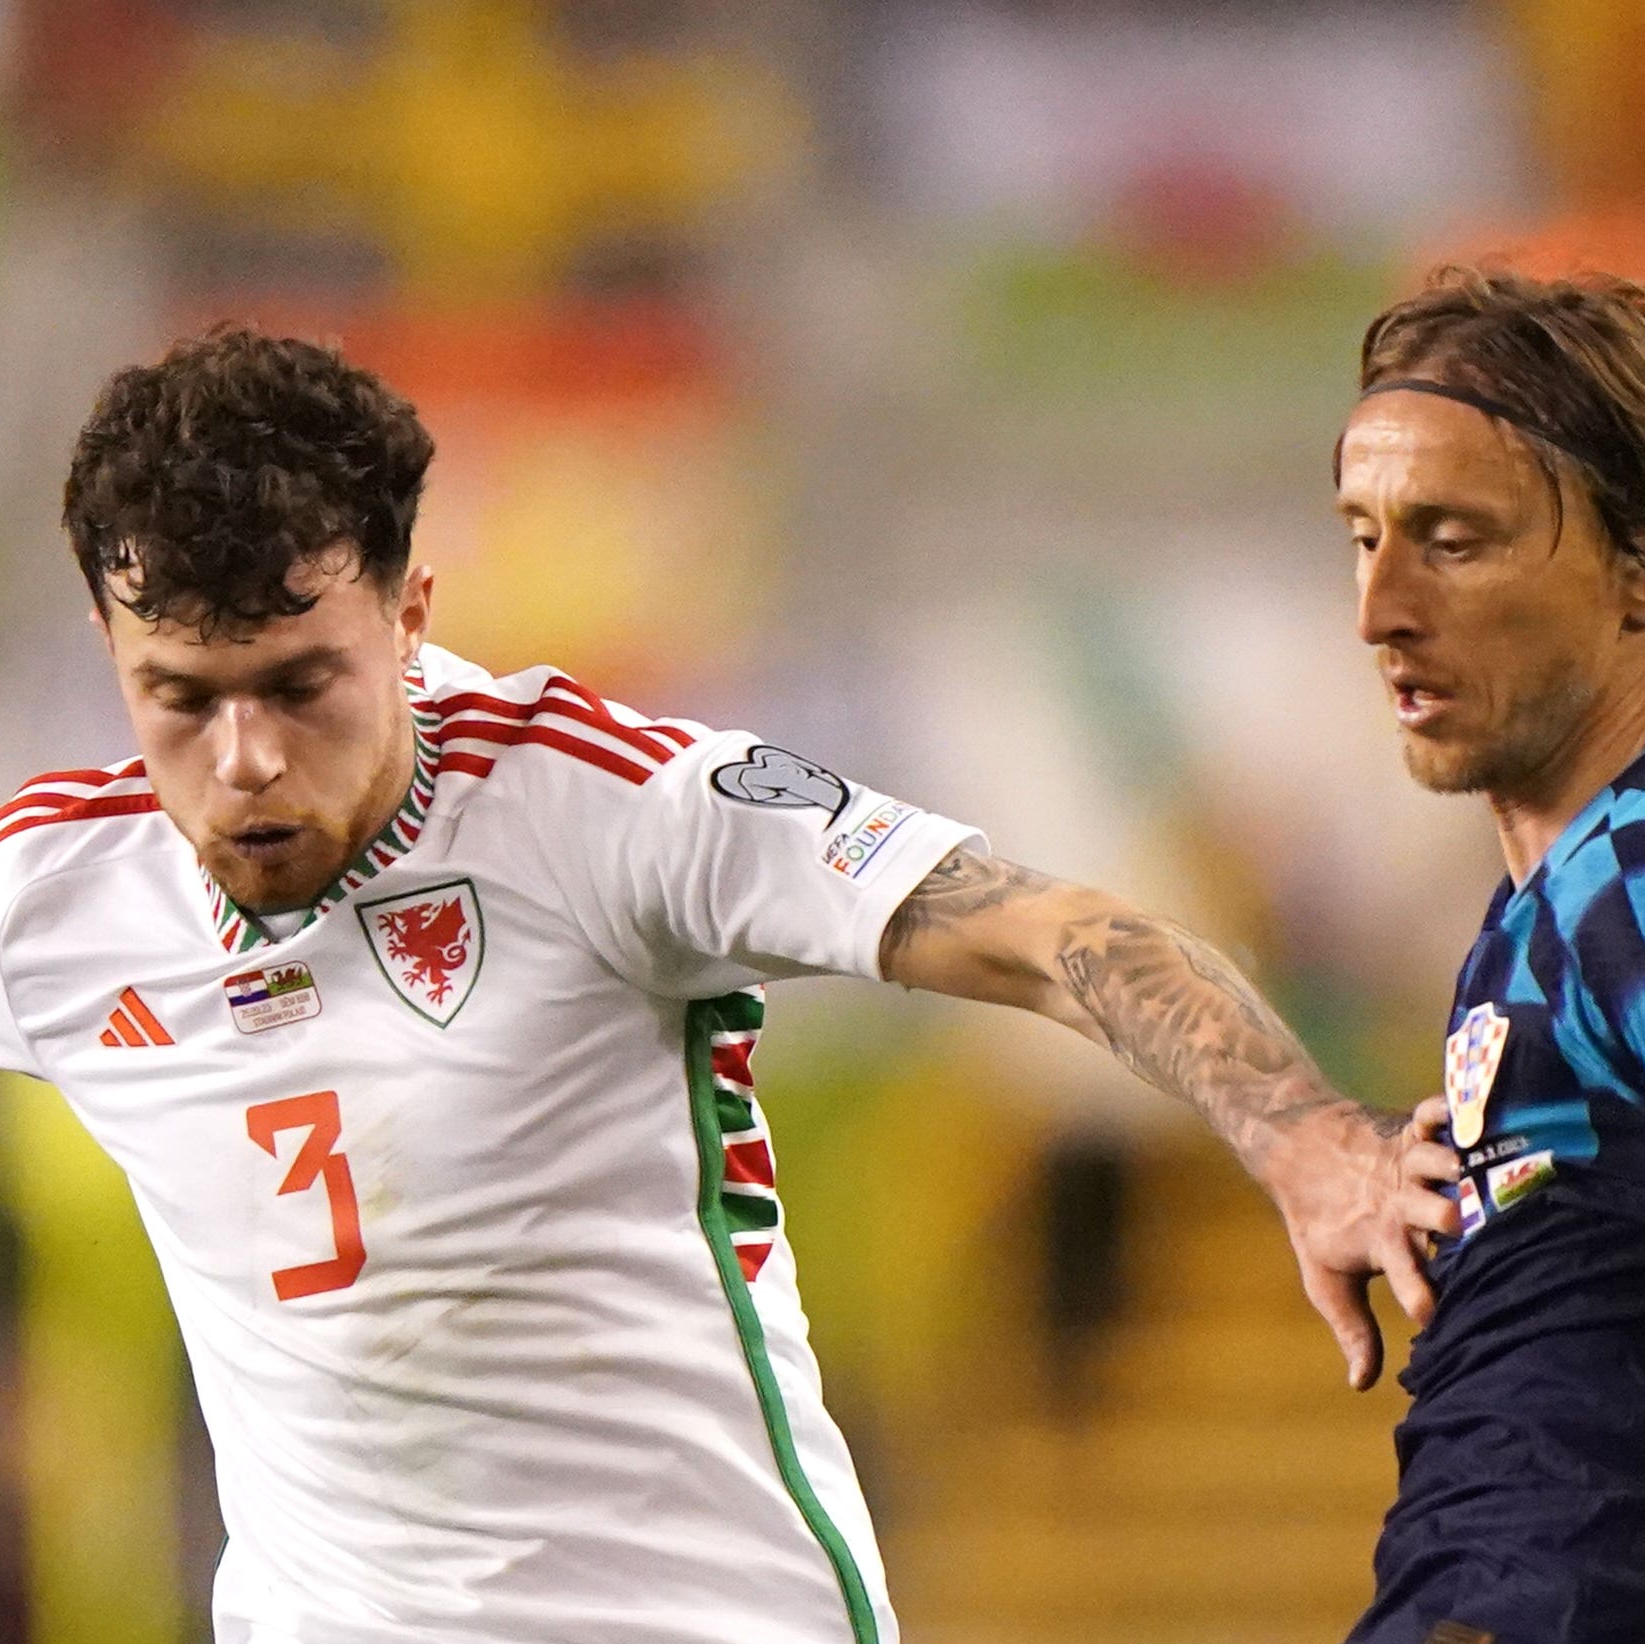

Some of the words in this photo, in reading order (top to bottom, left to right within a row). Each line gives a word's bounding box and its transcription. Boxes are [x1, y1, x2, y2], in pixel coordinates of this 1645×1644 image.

[821, 832, 850, 865] UEFA
[832, 802, 909, 876] FOUNDA
[246, 1090, 367, 1302] 3
